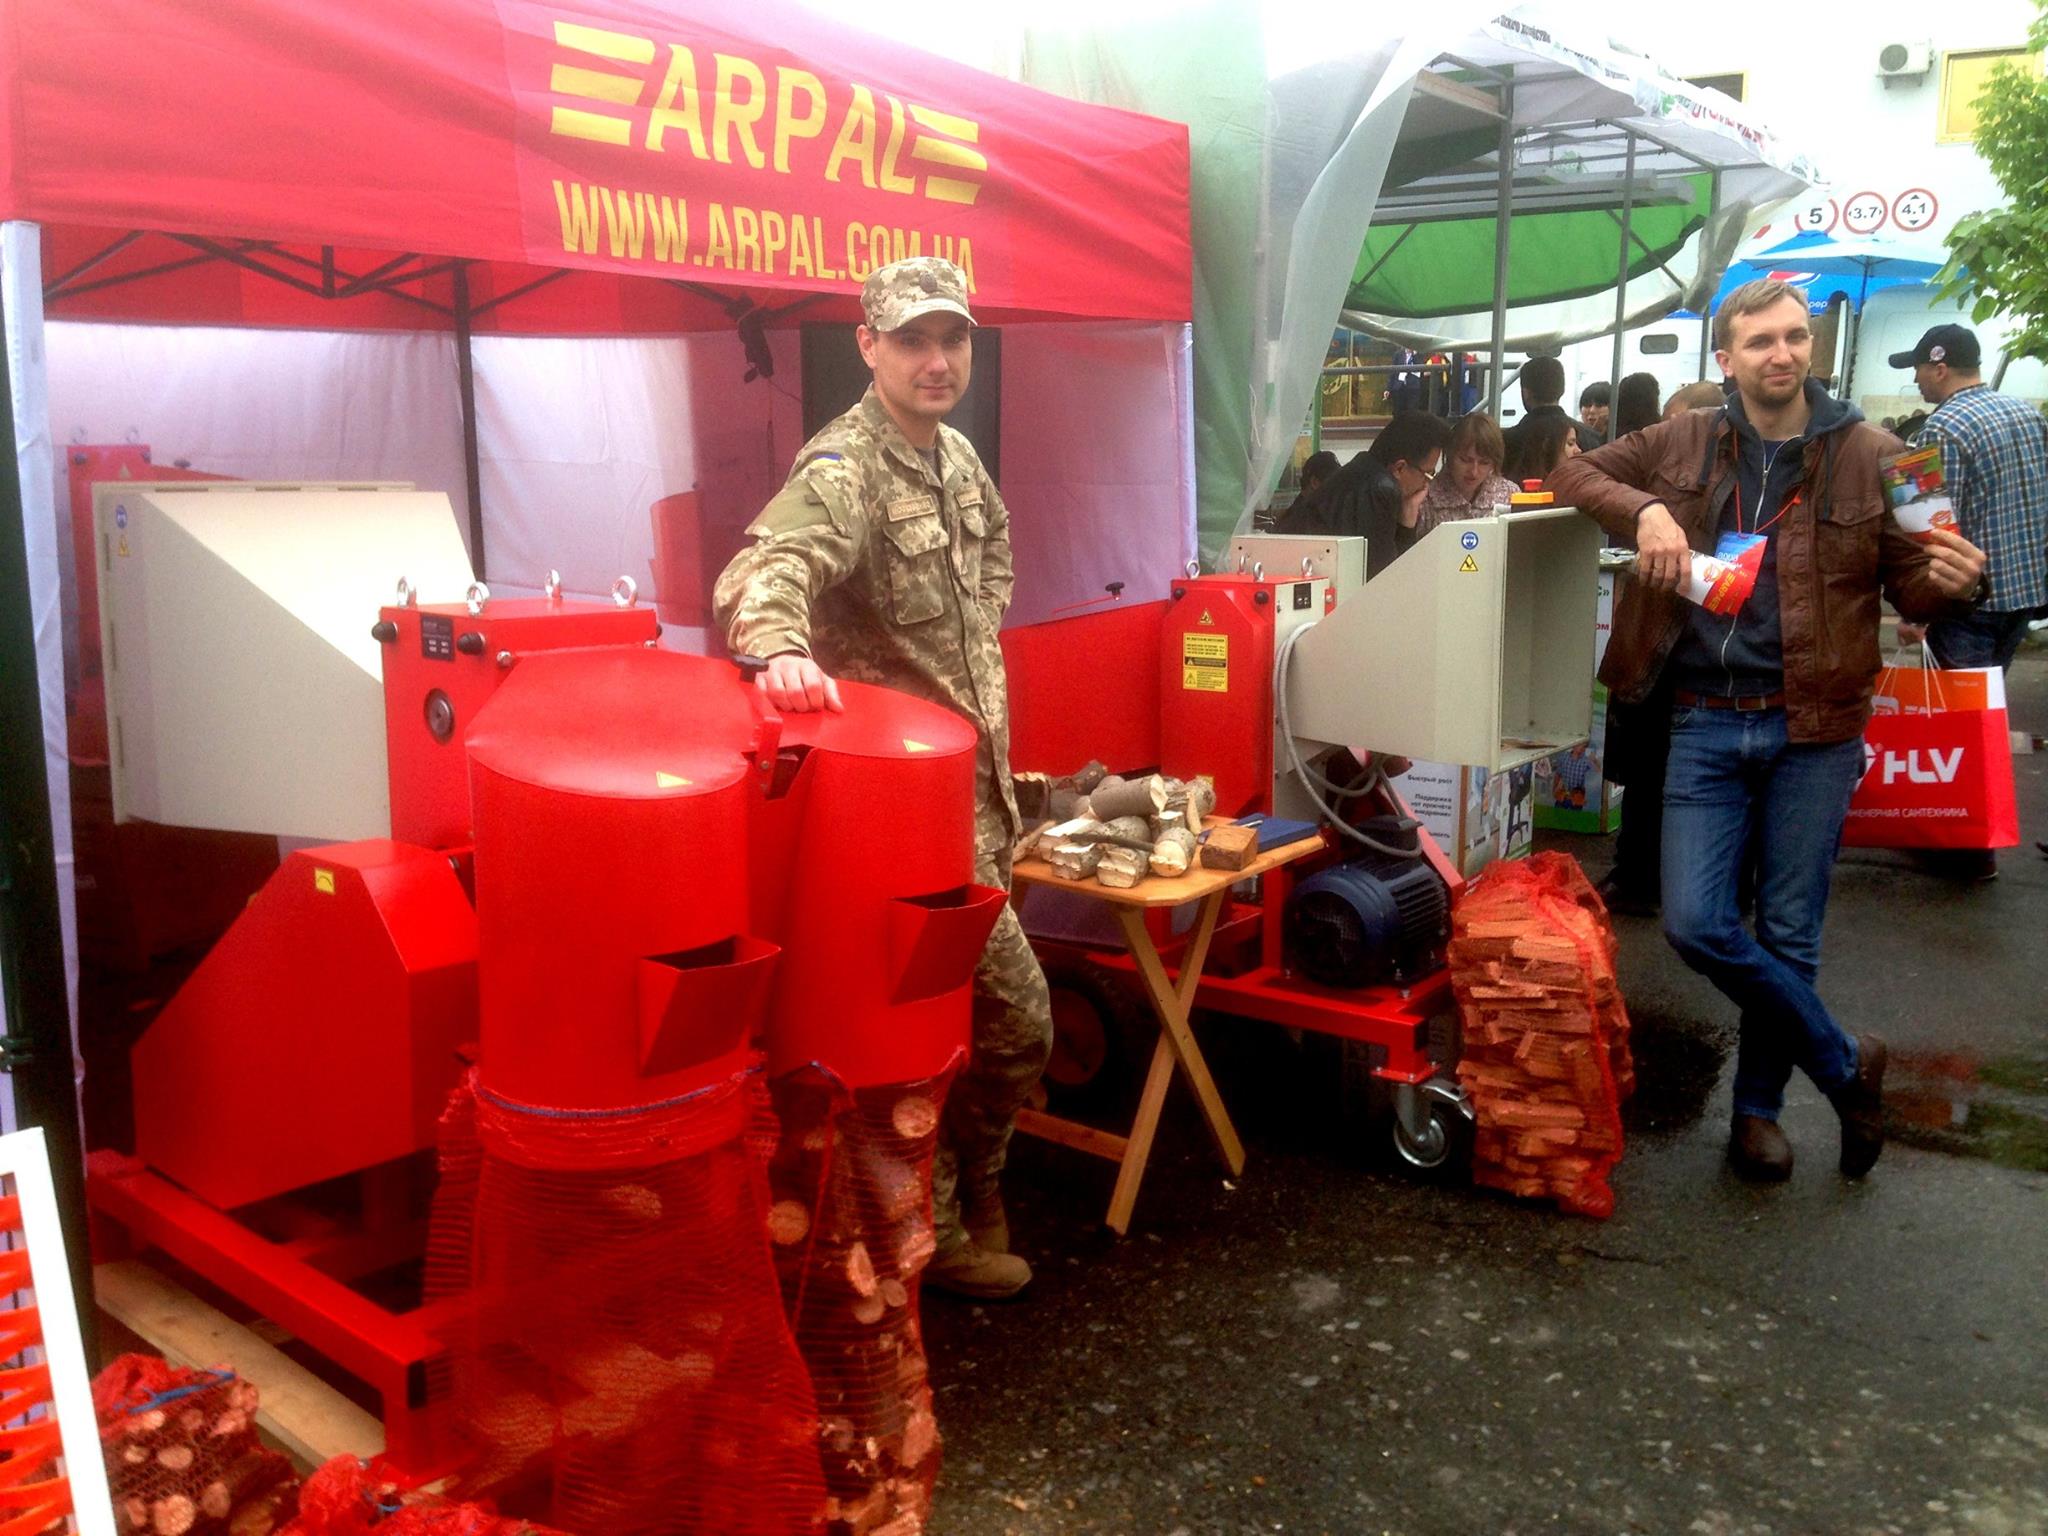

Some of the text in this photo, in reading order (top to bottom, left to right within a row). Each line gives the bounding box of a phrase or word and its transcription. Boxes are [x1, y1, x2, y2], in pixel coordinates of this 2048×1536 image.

[644, 42, 918, 196] ARPAL
[1809, 207, 1823, 224] 5
[1853, 206, 1880, 219] 3.7
[1902, 202, 1927, 215] 4.1
[552, 179, 978, 295] WWW.ARPAL.COMA
[1882, 747, 1965, 785] HLV
[1902, 807, 1968, 818] САНТЕХНИКА
